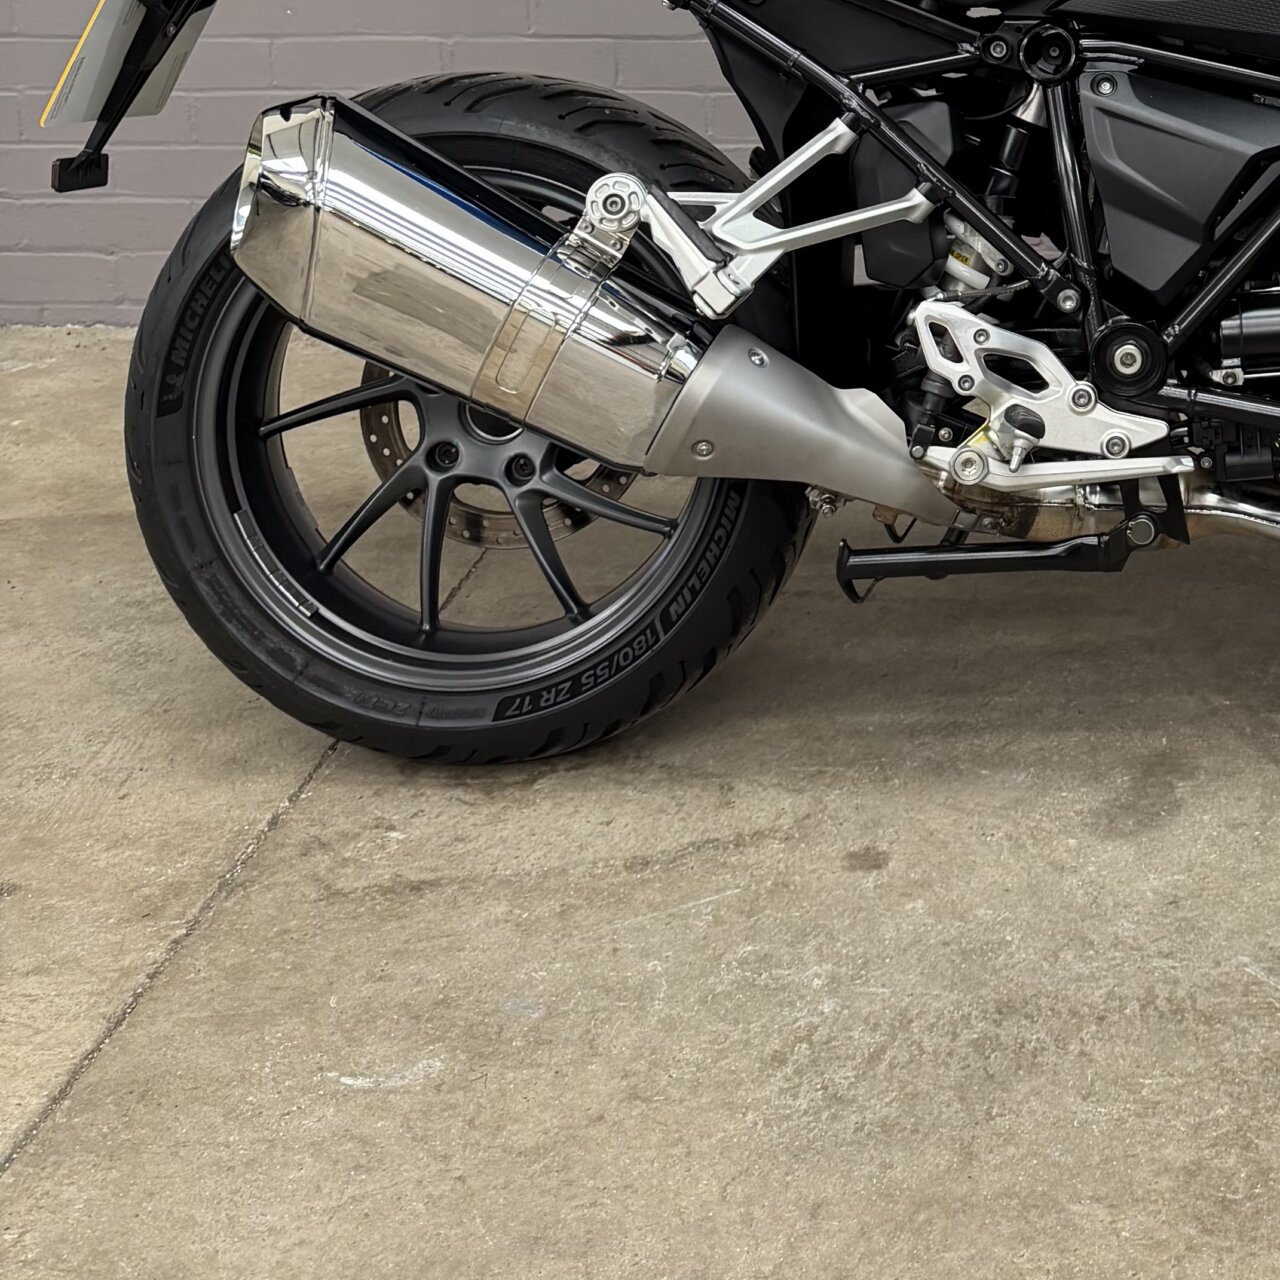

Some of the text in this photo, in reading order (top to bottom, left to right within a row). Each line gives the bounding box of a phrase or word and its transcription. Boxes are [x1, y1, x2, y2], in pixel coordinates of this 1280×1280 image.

[170, 250, 231, 367] MICHELI
[505, 489, 740, 716] MICHELIN 180/55 ZR 17
